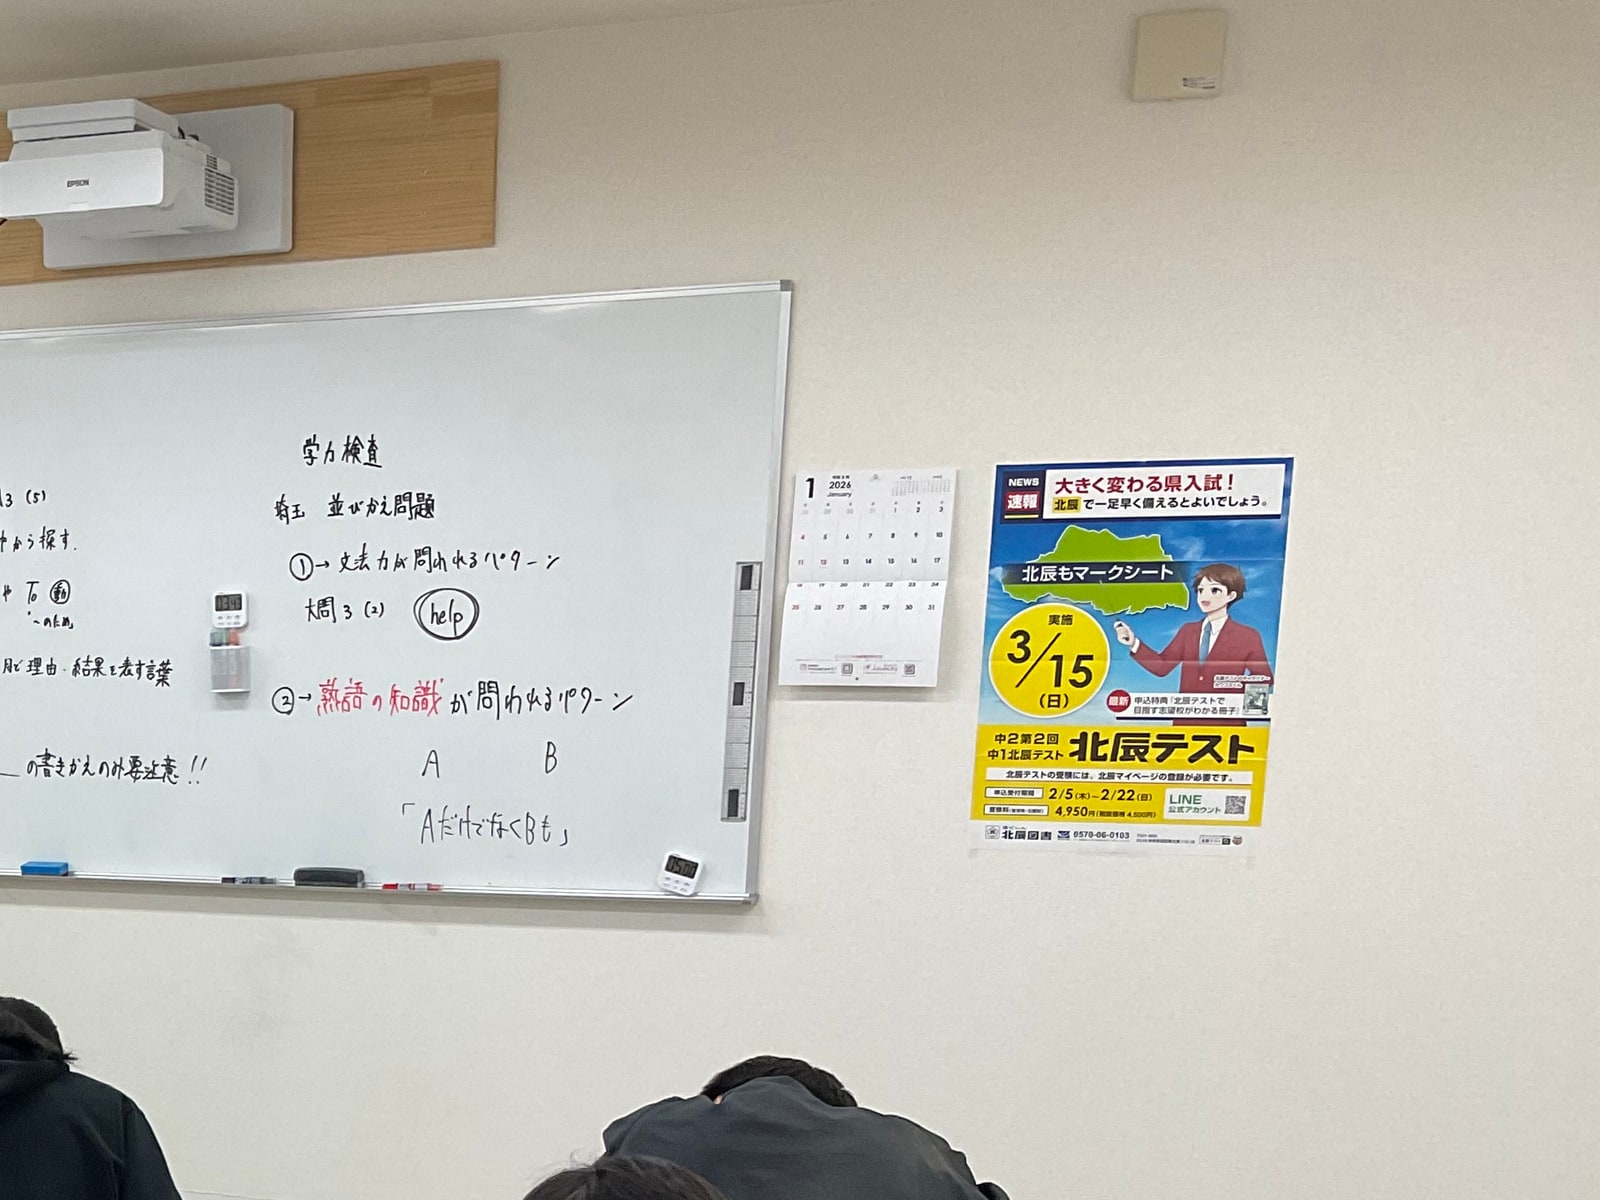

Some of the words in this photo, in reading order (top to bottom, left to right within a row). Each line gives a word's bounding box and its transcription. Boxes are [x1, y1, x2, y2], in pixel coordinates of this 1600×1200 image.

[66, 179, 90, 188] EPSON
[302, 433, 383, 468] 学力検査
[805, 477, 815, 499] 1
[828, 481, 852, 490] 2026
[1008, 478, 1040, 487] NEWS
[1007, 493, 1039, 510] 速報
[1021, 564, 1175, 582] 北辰もマークシート
[430, 598, 464, 637] help
[1048, 614, 1073, 626] 実施
[1039, 693, 1069, 709] (日)
[994, 733, 1060, 745] 中2第2回
[987, 748, 1065, 761] 中1北辰テスト
[1068, 731, 1255, 765] 北辰テスト
[421, 749, 441, 778] A
[544, 740, 558, 774] B
[1169, 794, 1202, 805] LINE
[1168, 806, 1221, 814] 公式アカウント
